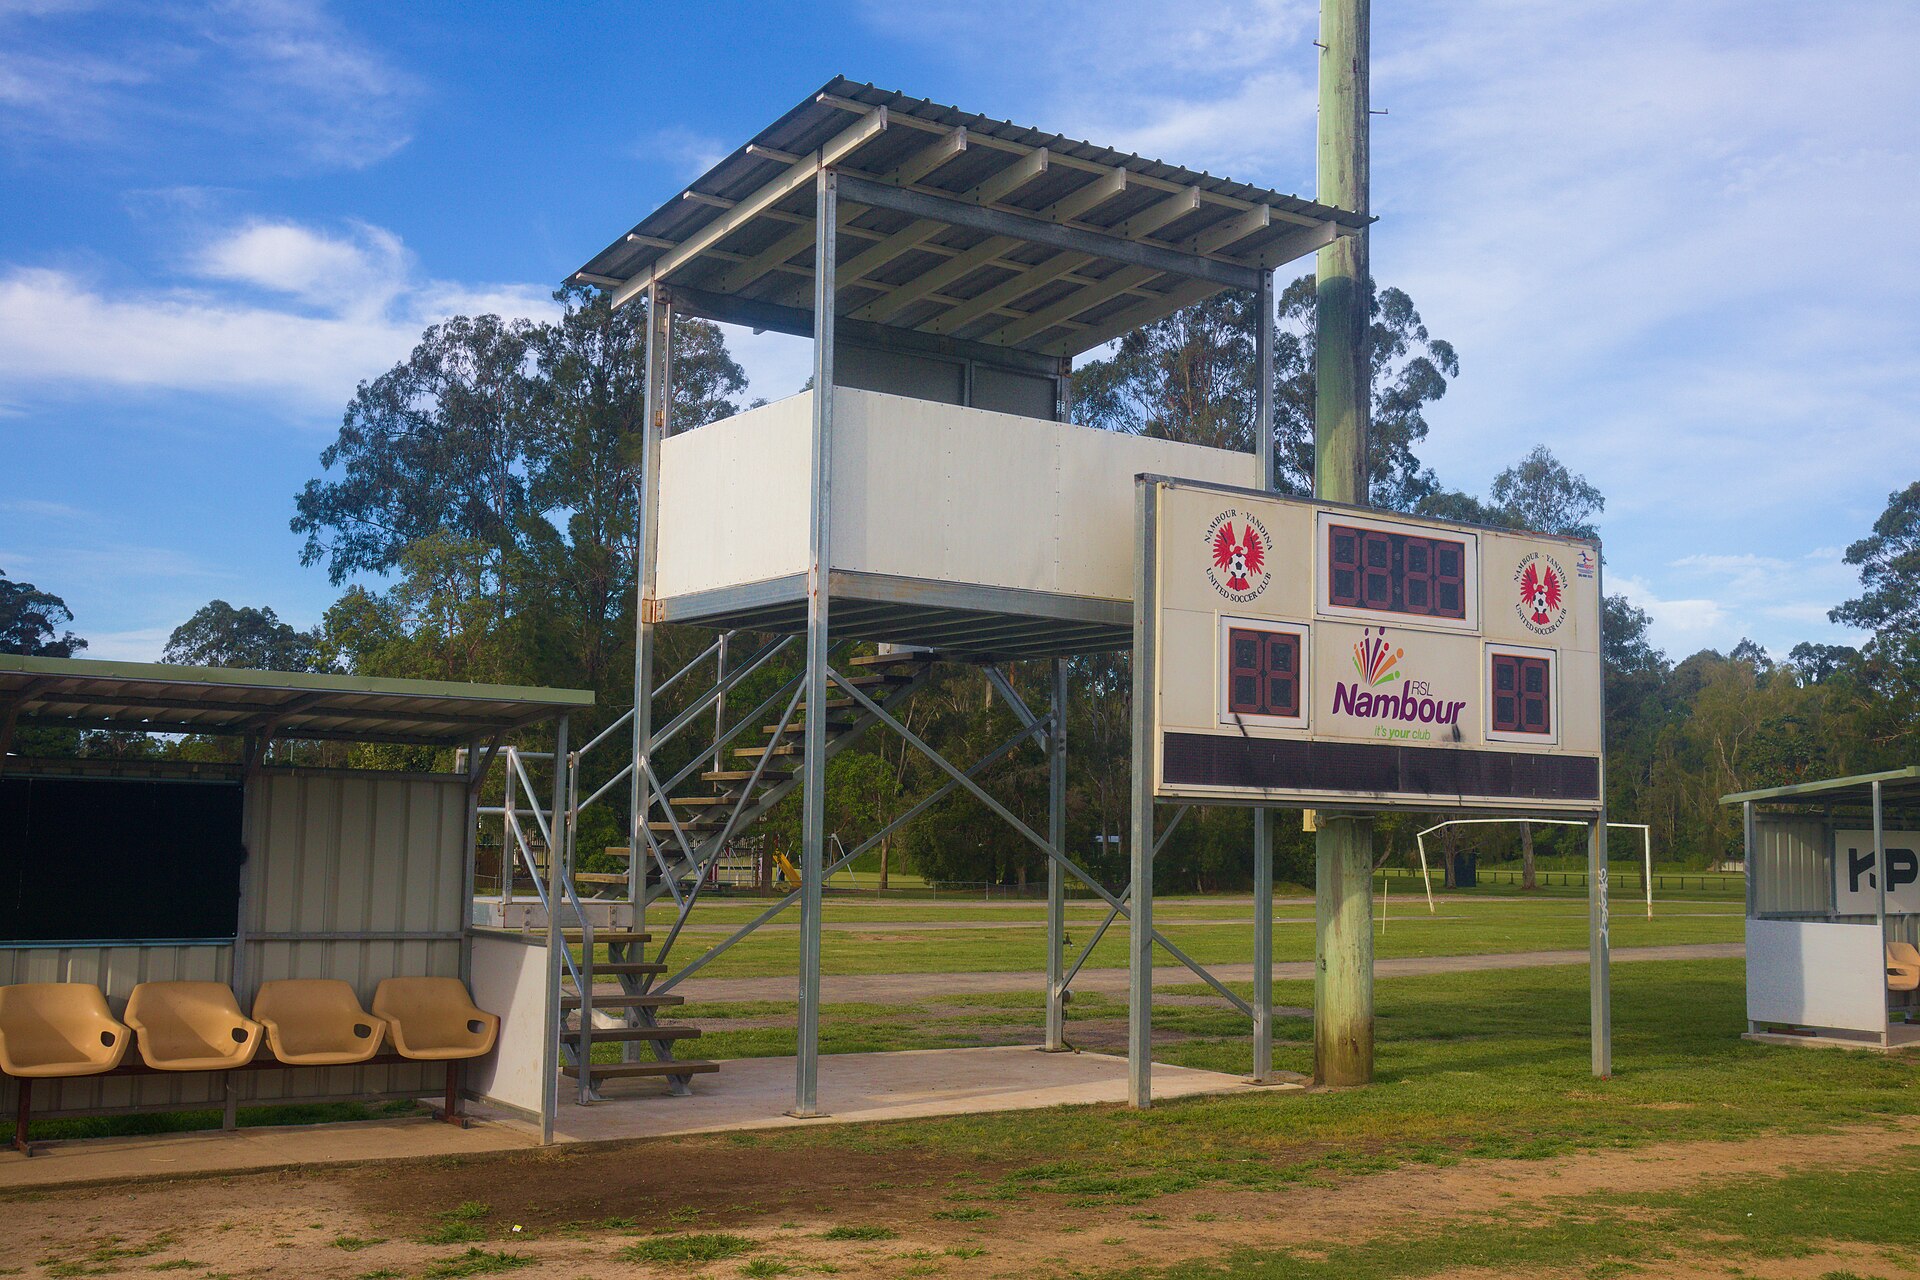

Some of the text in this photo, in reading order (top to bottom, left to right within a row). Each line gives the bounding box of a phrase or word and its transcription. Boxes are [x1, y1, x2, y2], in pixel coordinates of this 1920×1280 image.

[1204, 509, 1273, 551] NAMBOUR YANDINA
[1206, 567, 1272, 603] UNITED SOCCER CLUB
[1514, 552, 1568, 589] NAMBOUR YANDINA
[1515, 603, 1567, 636] UNITED SOCCER CLUB
[1332, 680, 1466, 724] Nambour
[1411, 681, 1433, 697] RSL
[1374, 725, 1431, 740] it's your club
